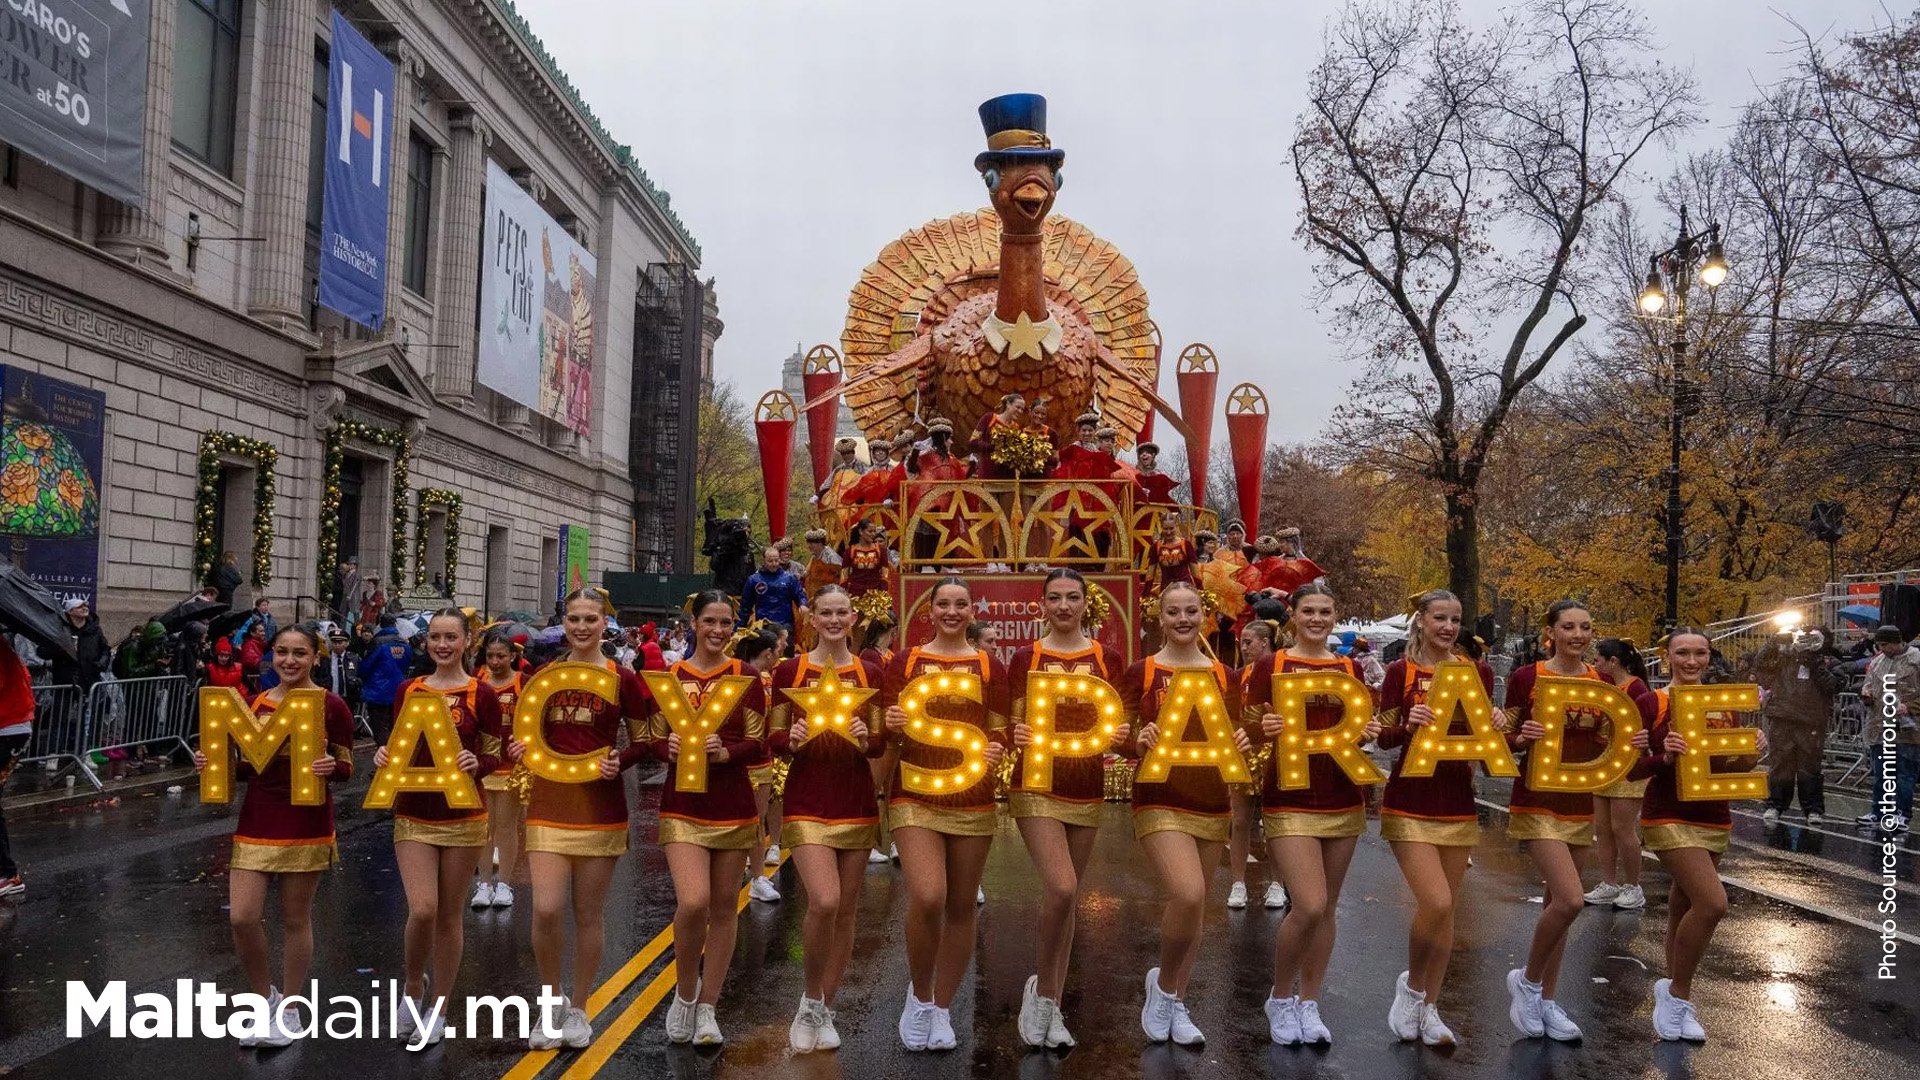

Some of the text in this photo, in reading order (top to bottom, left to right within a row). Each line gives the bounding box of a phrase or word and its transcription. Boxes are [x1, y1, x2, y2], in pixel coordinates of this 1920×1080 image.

[36, 81, 91, 126] at 50
[333, 232, 350, 252] THE
[496, 208, 527, 286] PETS
[333, 244, 378, 280] HISTORICAL
[30, 573, 92, 584] GALLERY OF
